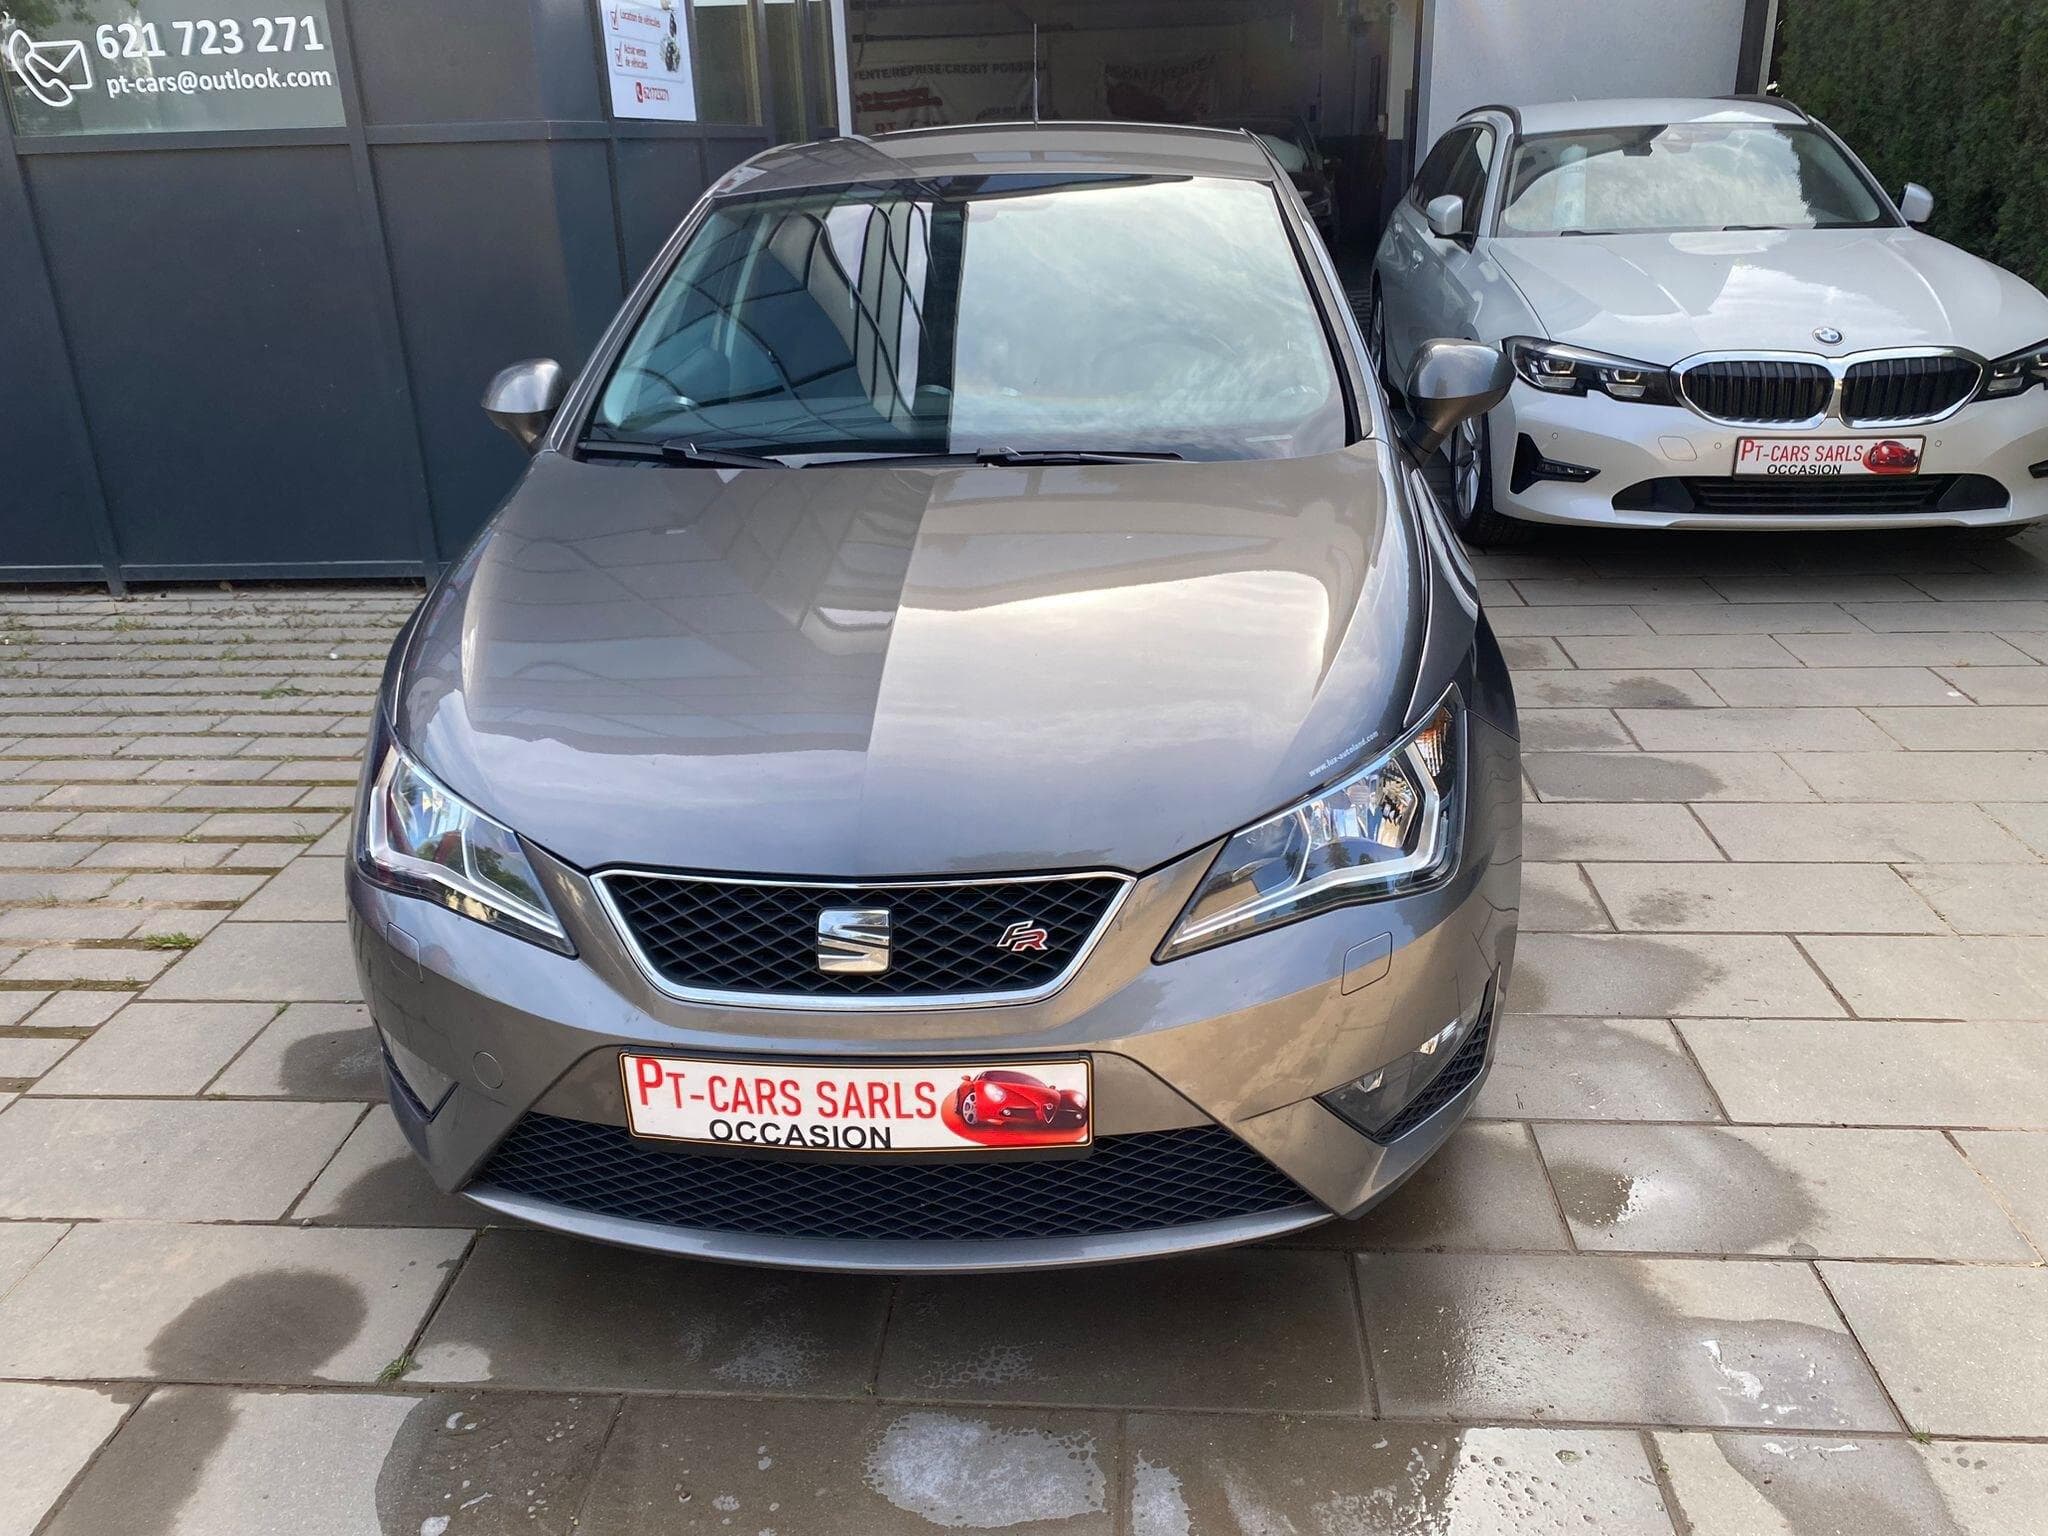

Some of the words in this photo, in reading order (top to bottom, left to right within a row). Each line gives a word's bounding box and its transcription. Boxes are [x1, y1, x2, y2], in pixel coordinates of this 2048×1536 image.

[96, 22, 166, 59] 621
[172, 19, 244, 56] 723
[252, 15, 325, 53] 271
[106, 67, 332, 98] pt-cars@outlook.com
[1815, 445, 1863, 462] SARLS
[1767, 464, 1842, 475] OCCASION
[1308, 730, 1379, 777] www.lux-autoland.com
[996, 920, 1048, 951] FR
[817, 1078, 937, 1120] SARLS
[708, 1118, 891, 1149] OCCASION
